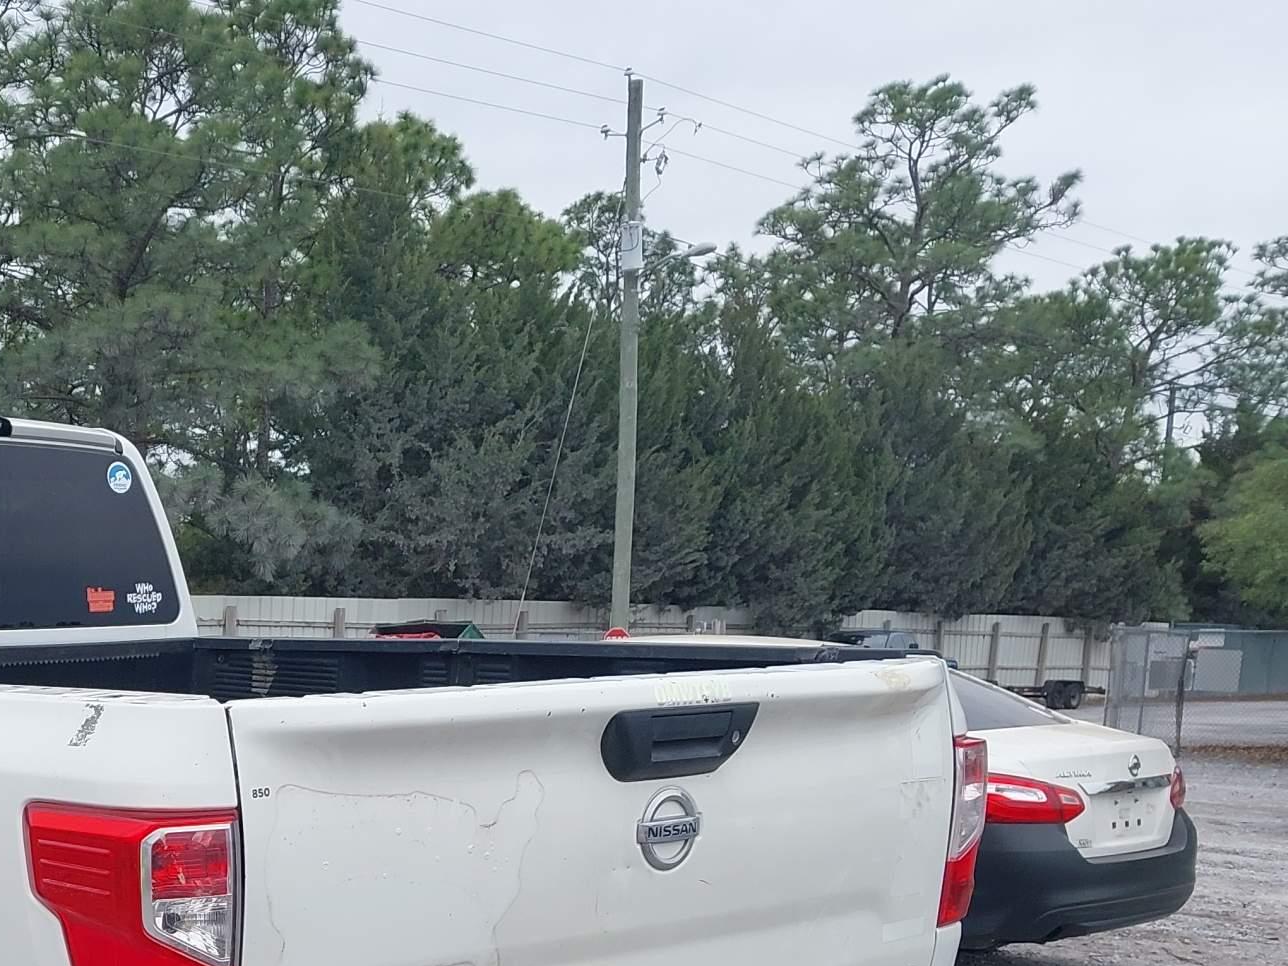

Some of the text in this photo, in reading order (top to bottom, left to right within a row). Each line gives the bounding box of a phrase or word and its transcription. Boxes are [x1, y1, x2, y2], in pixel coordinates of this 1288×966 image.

[126, 592, 163, 603] RESCUED
[252, 787, 271, 799] 850
[647, 821, 697, 838] NISSAN
